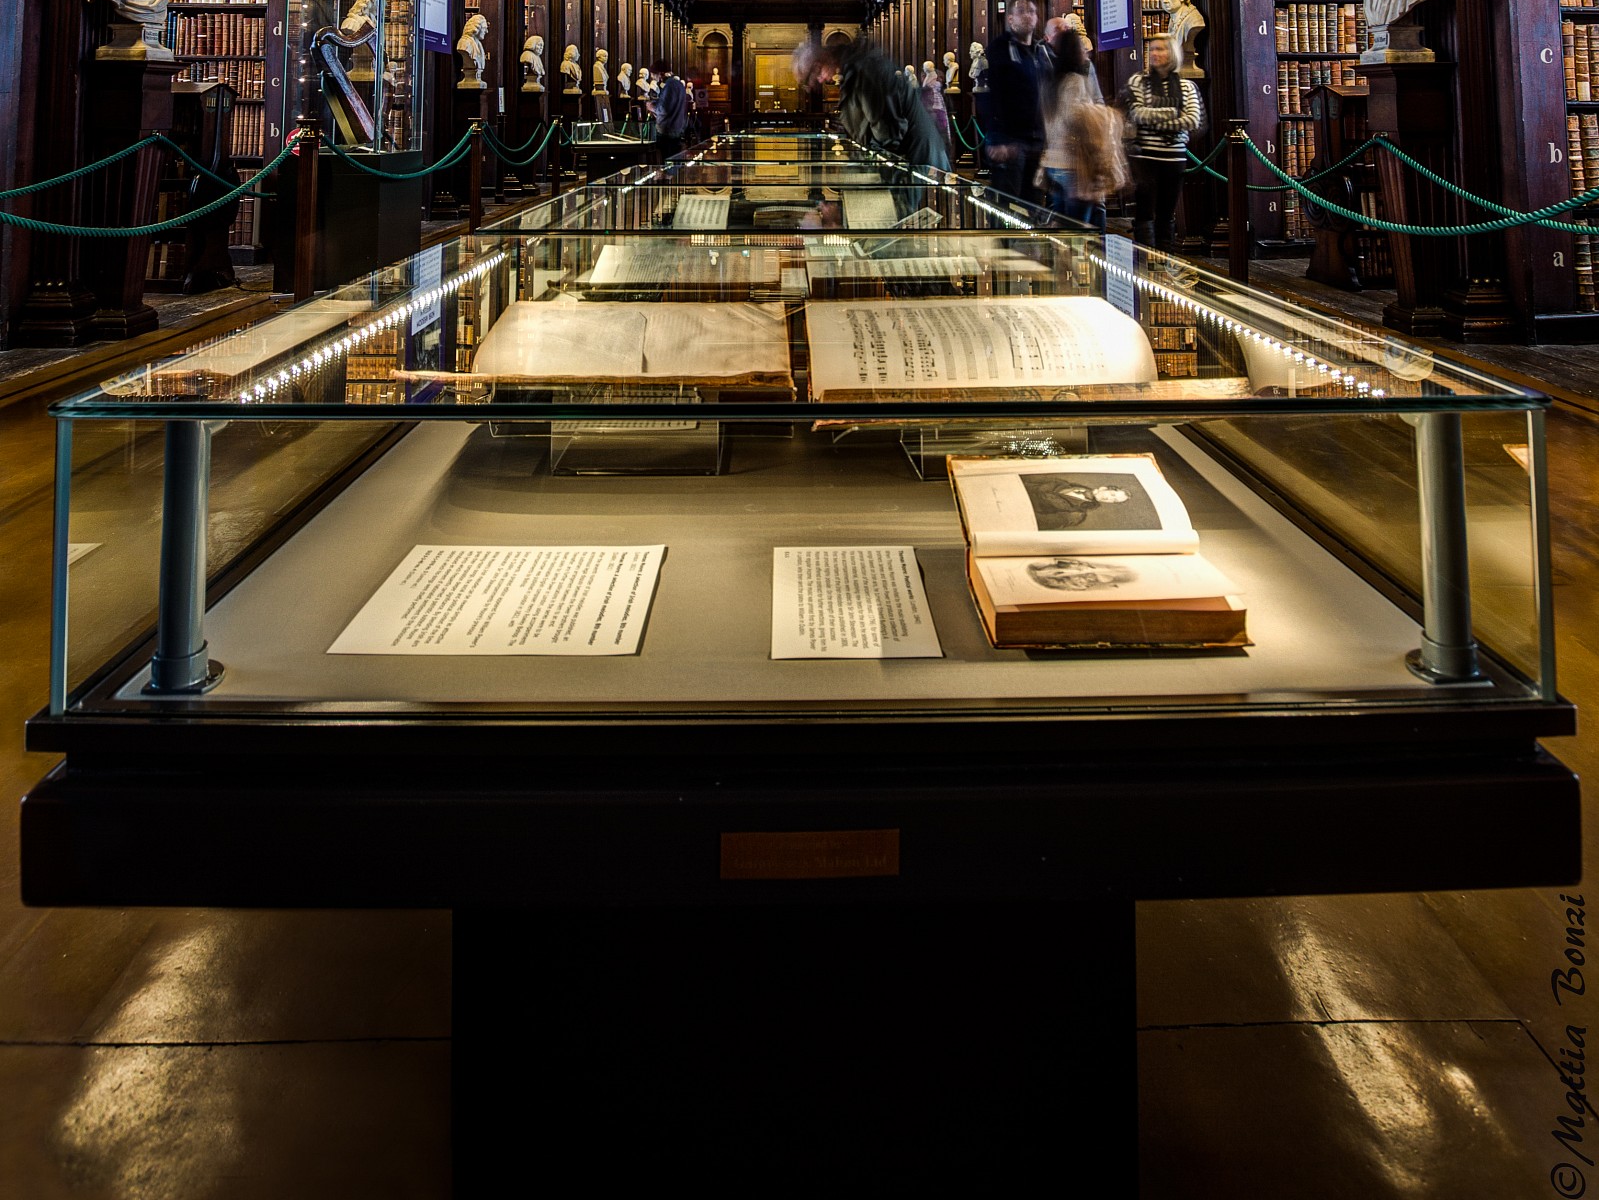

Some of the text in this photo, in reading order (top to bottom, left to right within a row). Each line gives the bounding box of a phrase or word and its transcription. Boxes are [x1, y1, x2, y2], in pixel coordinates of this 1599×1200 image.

[273, 21, 282, 35] d
[1259, 21, 1267, 35] d
[1540, 48, 1553, 63] c
[270, 123, 279, 137] b
[1267, 140, 1275, 153] b
[1548, 142, 1562, 163] b
[1553, 252, 1564, 267] a
